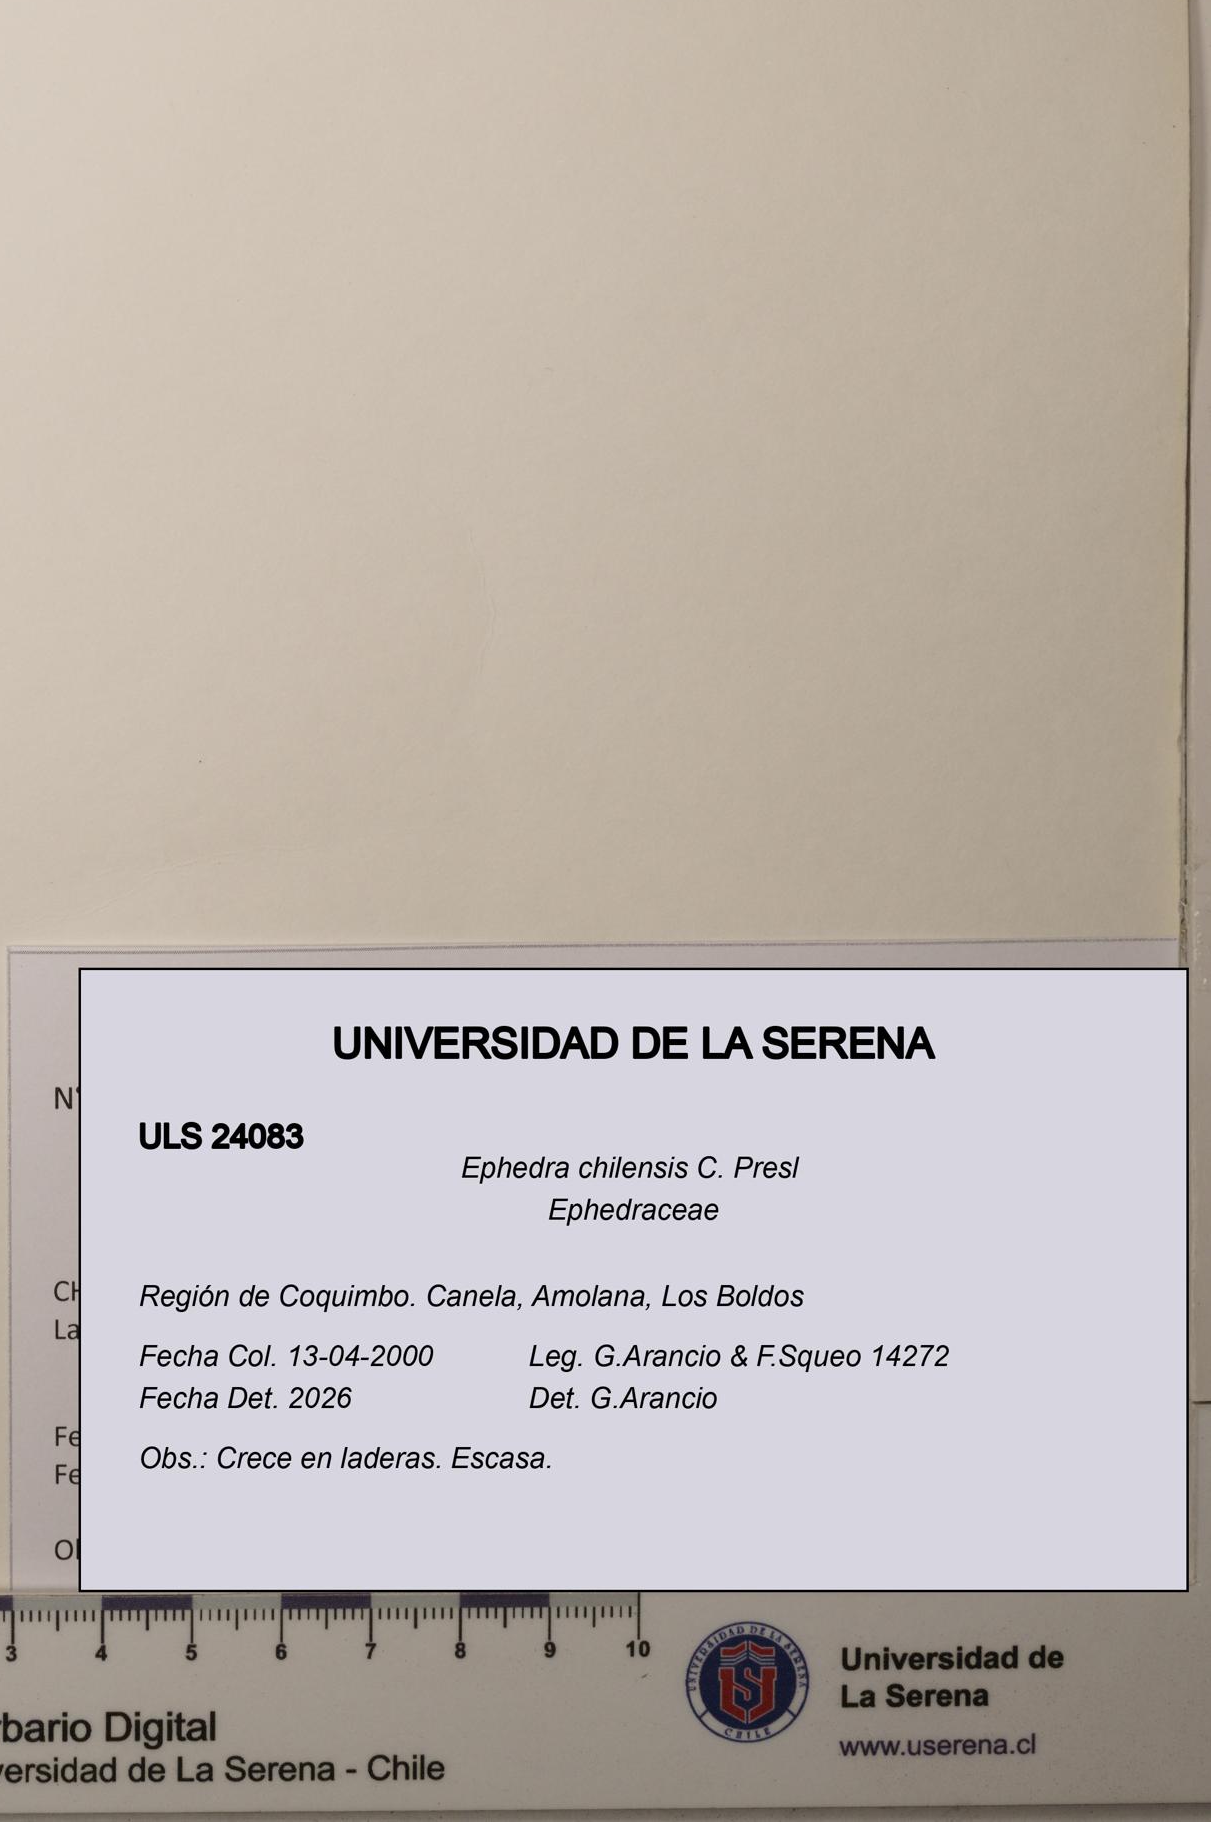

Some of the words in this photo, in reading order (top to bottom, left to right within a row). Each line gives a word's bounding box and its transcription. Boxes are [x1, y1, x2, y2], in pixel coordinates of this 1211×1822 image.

[54, 1538, 79, 1561] O
[5, 1644, 18, 1663] 3
[94, 1644, 108, 1662] 4
[185, 1643, 198, 1662] 5
[275, 1643, 288, 1661] 6
[364, 1642, 377, 1660] 7
[454, 1641, 467, 1660] 8
[543, 1640, 557, 1659] 9
[625, 1639, 651, 1658] 10
[841, 1644, 1019, 1672] Universidad
[1028, 1644, 1065, 1670] de
[841, 1684, 876, 1709] La
[885, 1682, 990, 1708] Serena
[105, 1710, 216, 1748] Digital
[838, 1732, 1036, 1757] www.userena.cl
[127, 1756, 166, 1783] de
[176, 1755, 214, 1783] La
[224, 1755, 336, 1783] Serena
[367, 1753, 446, 1782] Chile
